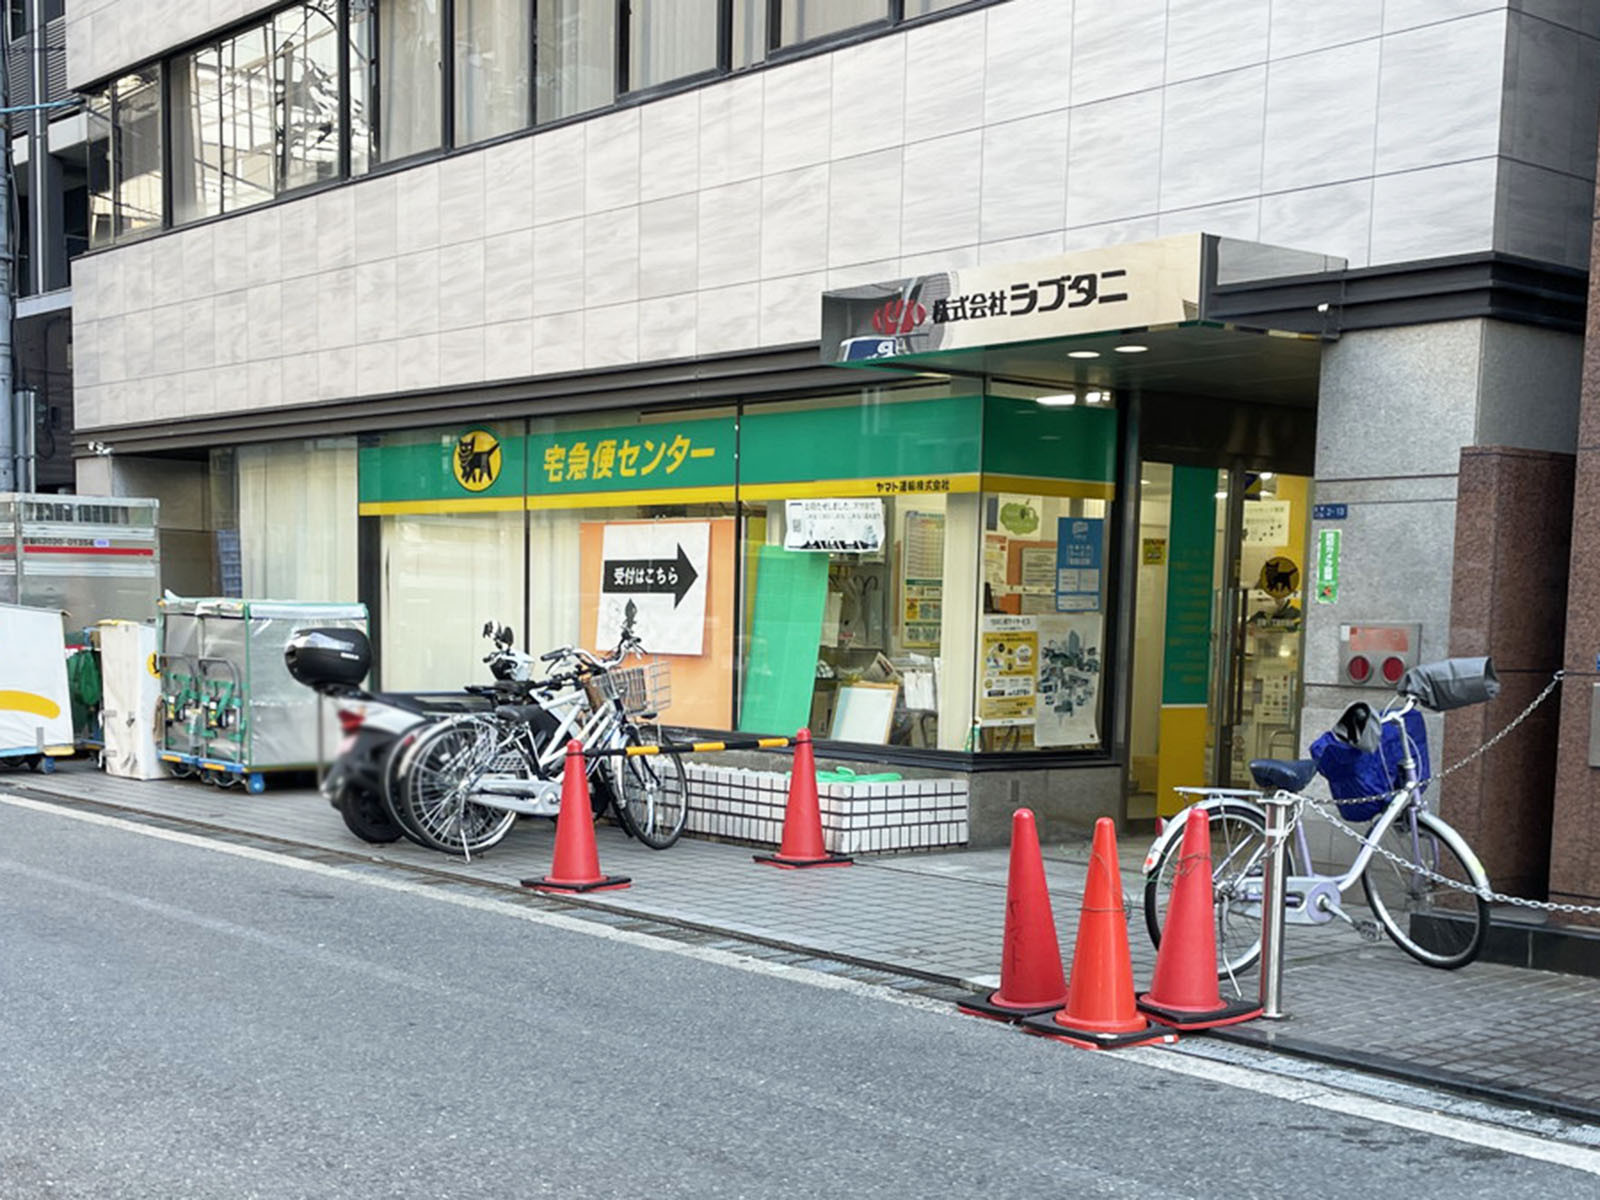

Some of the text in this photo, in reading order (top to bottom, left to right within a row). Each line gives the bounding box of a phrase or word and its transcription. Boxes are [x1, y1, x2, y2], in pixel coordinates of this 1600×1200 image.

[932, 269, 1128, 324] 株式会社シブタニ
[543, 434, 716, 483] 宅急便センター
[613, 566, 679, 586] 受付はこちら
